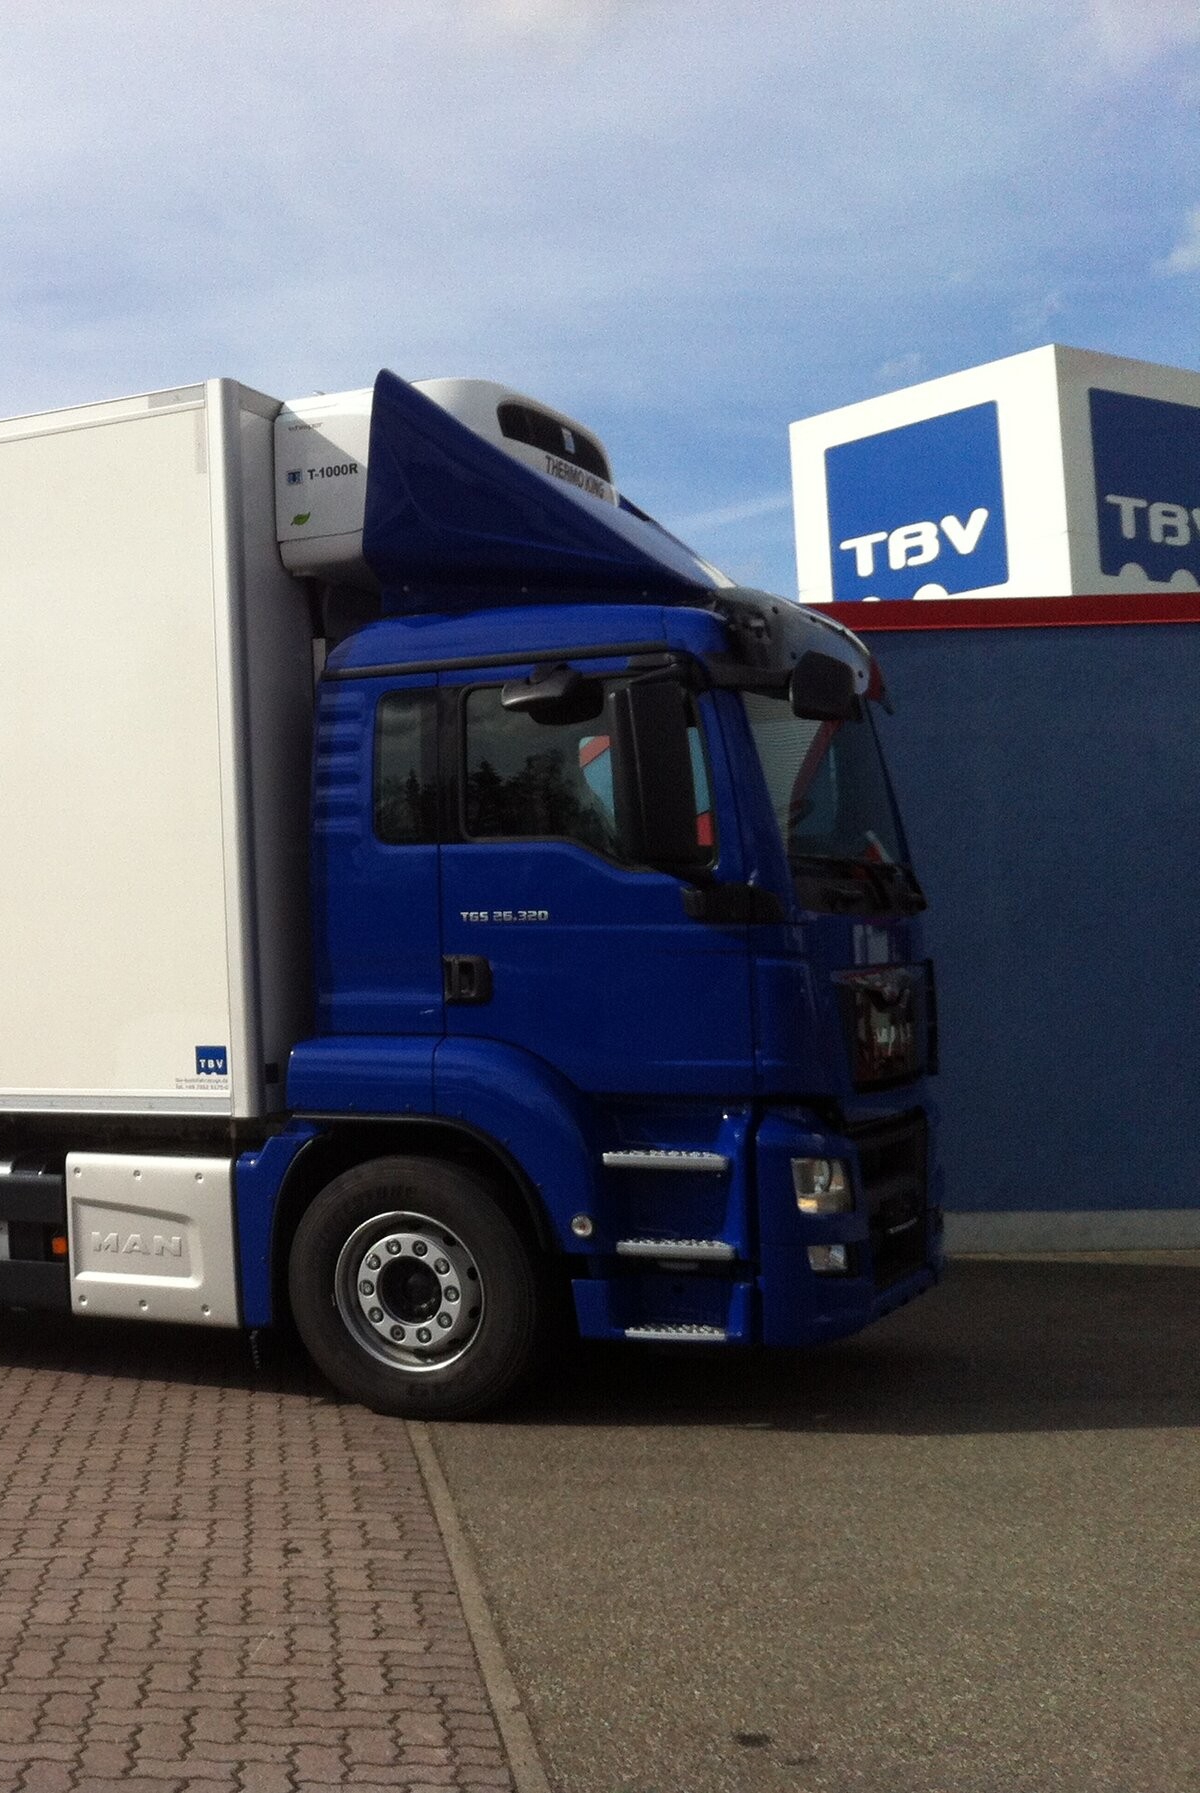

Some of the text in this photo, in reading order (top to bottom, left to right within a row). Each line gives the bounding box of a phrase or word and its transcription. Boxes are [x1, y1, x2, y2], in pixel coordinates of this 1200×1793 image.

[307, 463, 359, 480] T-1000R
[840, 507, 989, 577] TBV
[460, 910, 549, 922] TGS 26.320
[199, 1059, 223, 1069] TBV
[91, 1231, 182, 1257] MAN
